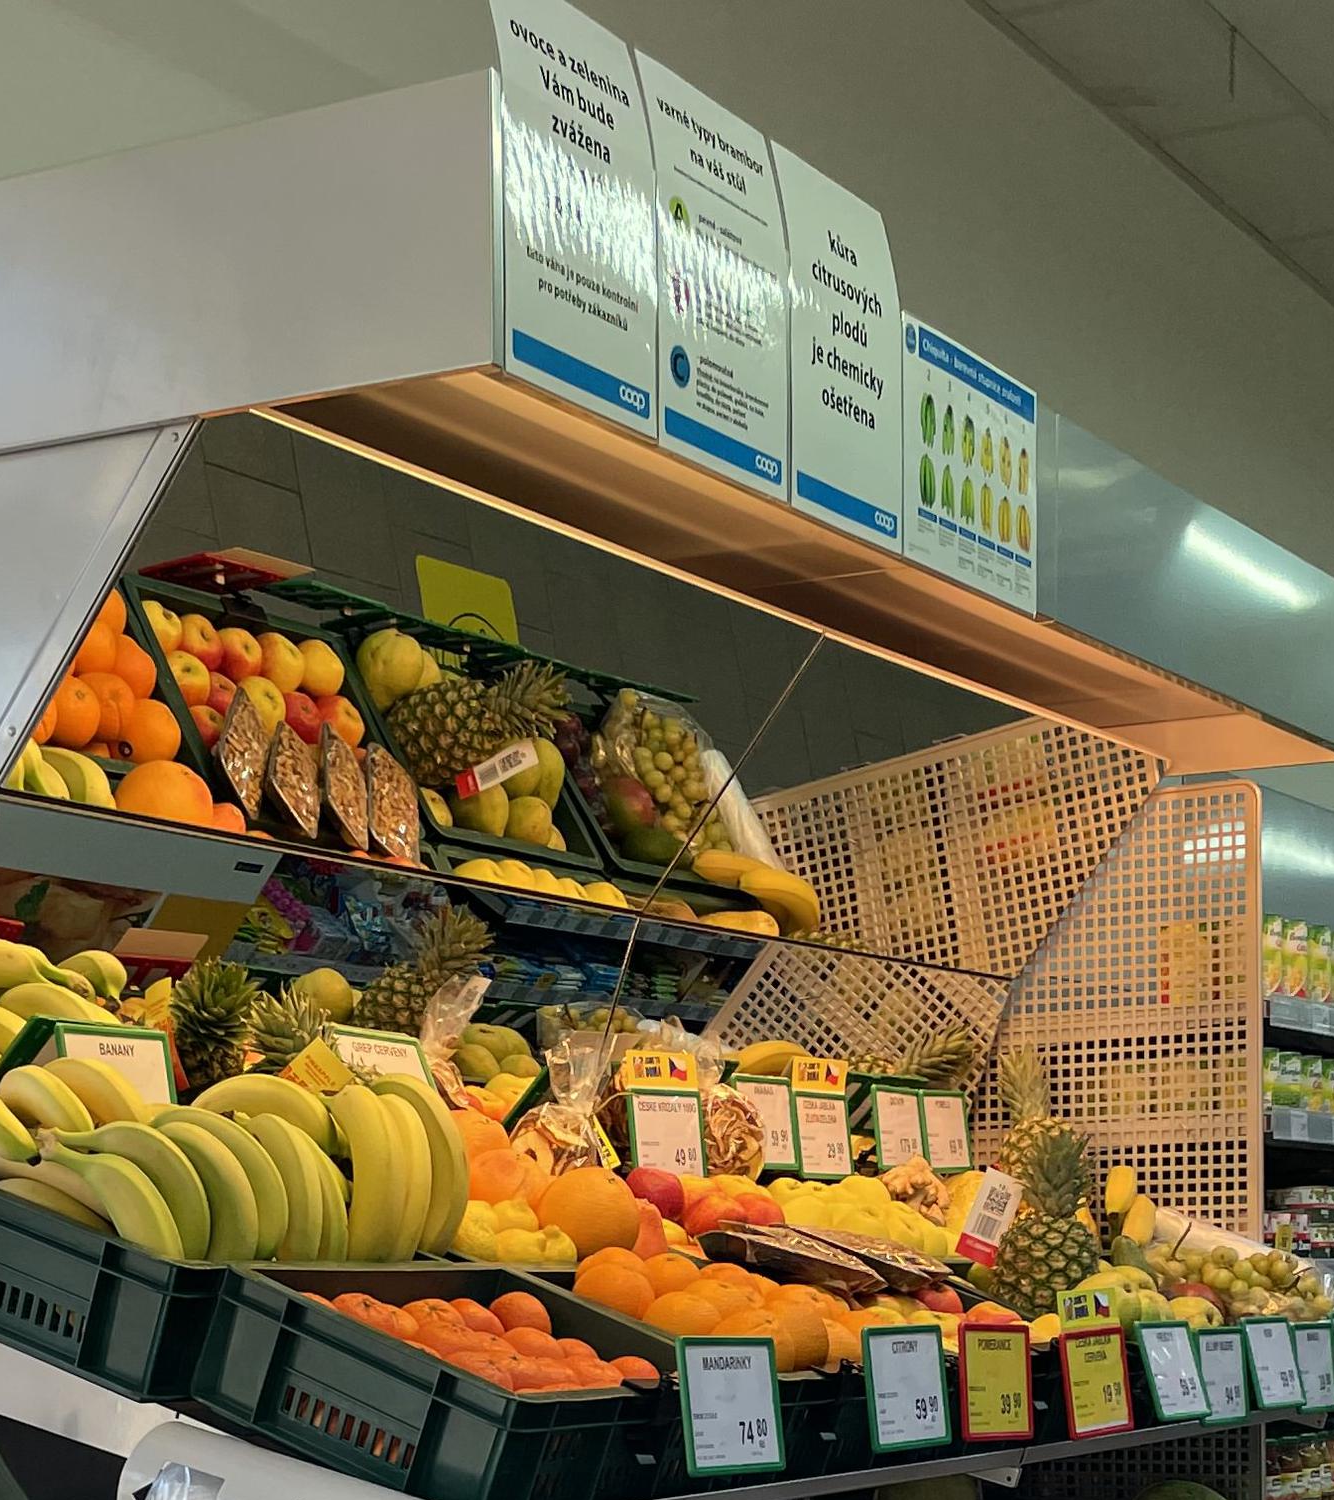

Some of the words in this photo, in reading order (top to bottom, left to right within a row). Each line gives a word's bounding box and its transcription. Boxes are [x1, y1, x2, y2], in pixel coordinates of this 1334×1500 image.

[510, 19, 555, 60] ovoce
[559, 50, 566, 66] a
[569, 56, 629, 107] zelenina
[540, 66, 575, 106] Vám
[577, 89, 614, 130] bude
[552, 114, 610, 164] zvážena
[657, 96, 689, 126] varné
[691, 118, 716, 149] typy
[718, 132, 763, 176] brambor
[690, 148, 704, 167] na
[707, 155, 724, 179] váš
[828, 230, 857, 267] kůra
[538, 277, 553, 296] pro
[812, 261, 882, 318] citrusových
[832, 310, 867, 348] plodů
[812, 338, 824, 367] je
[827, 349, 883, 400] chemicky
[619, 384, 645, 411] coop
[822, 385, 876, 430] ošetřena
[755, 454, 778, 478] coop
[874, 510, 895, 533] coop
[98, 1042, 136, 1058] BANANY
[675, 1148, 686, 1166] 49
[702, 1356, 751, 1370] MANDARINKY
[916, 1399, 927, 1420] 59
[929, 1396, 939, 1412] 90
[1001, 1394, 1011, 1414] 39
[739, 1421, 754, 1444] 74
[756, 1419, 767, 1437] 80
